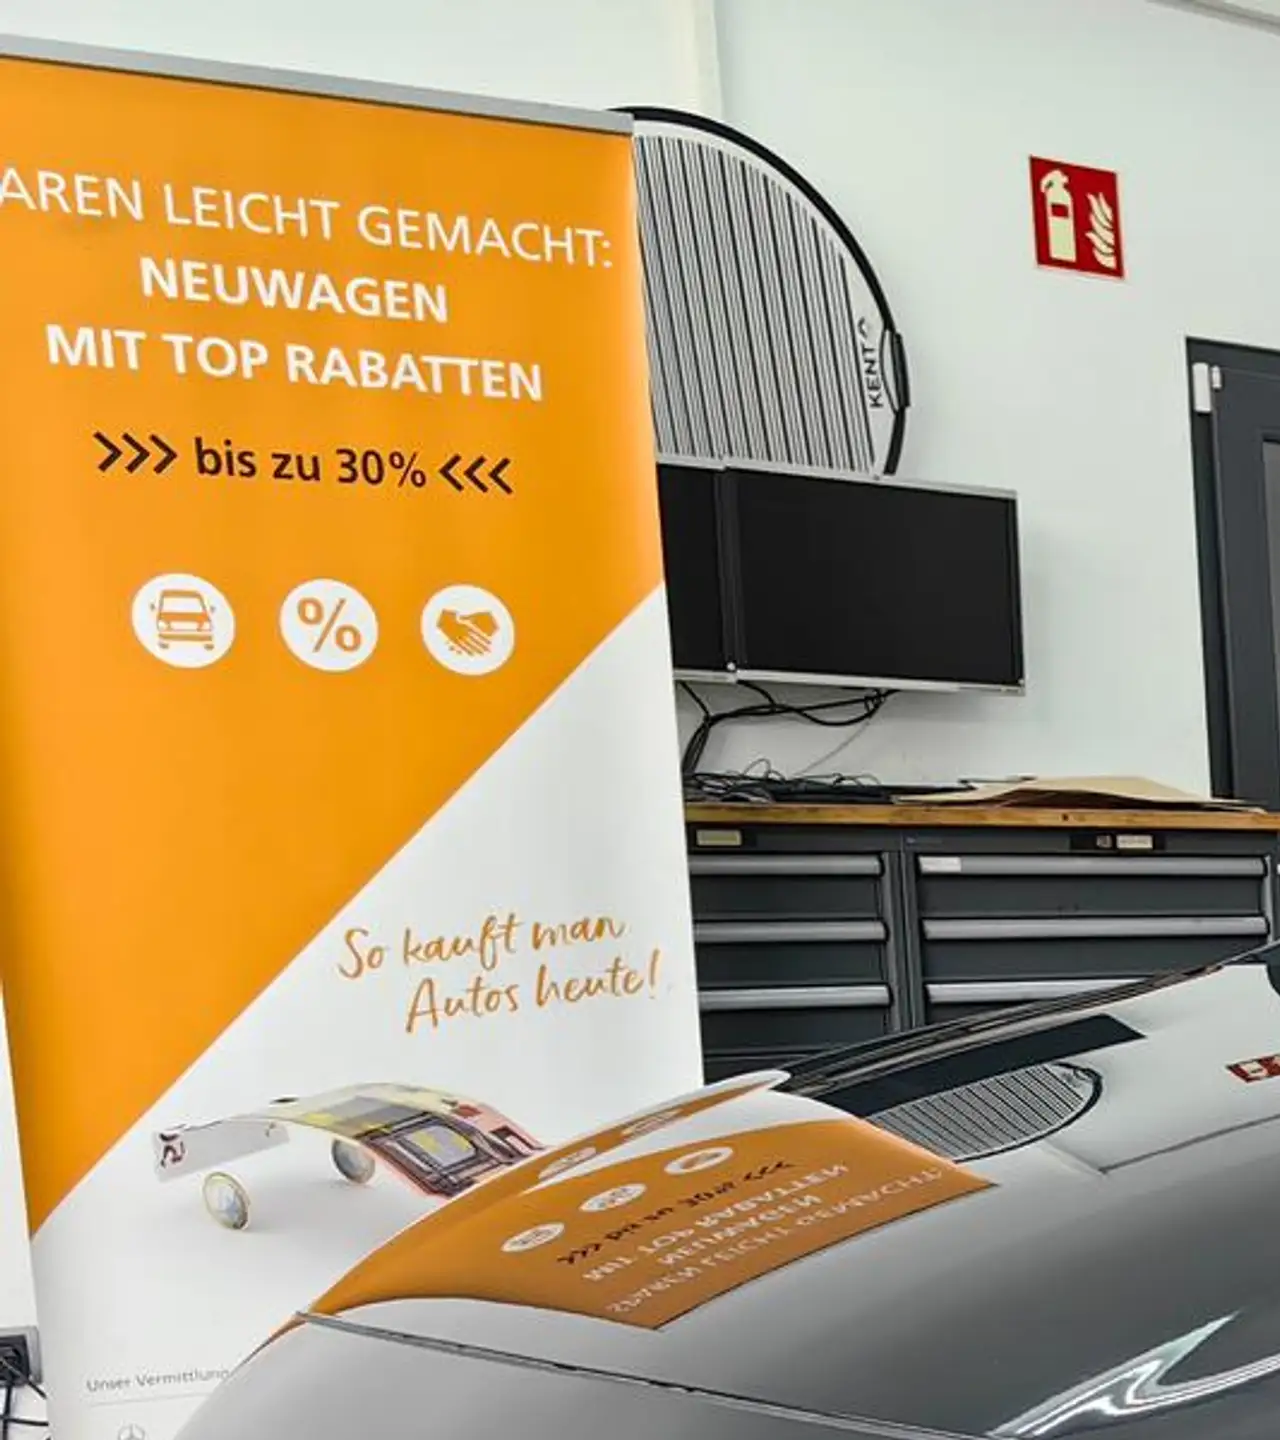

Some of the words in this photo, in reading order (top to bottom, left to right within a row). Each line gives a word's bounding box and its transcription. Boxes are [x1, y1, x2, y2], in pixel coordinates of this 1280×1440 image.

[163, 182, 341, 242] LEICHT
[357, 204, 613, 270] GEMACHT:
[140, 256, 449, 324] NEUWAGEN
[45, 324, 146, 373] MIT
[168, 333, 270, 381] TOP
[286, 344, 543, 402] RABATTEN
[861, 345, 884, 408] KENT
[194, 436, 257, 481] bis
[271, 450, 322, 484] zu
[335, 449, 428, 490] 30%
[338, 927, 388, 979] So
[402, 912, 524, 967] kauft
[531, 914, 627, 951] man
[405, 974, 520, 1034] Autos
[536, 948, 660, 1009] heute!
[86, 1376, 132, 1392] Unser
